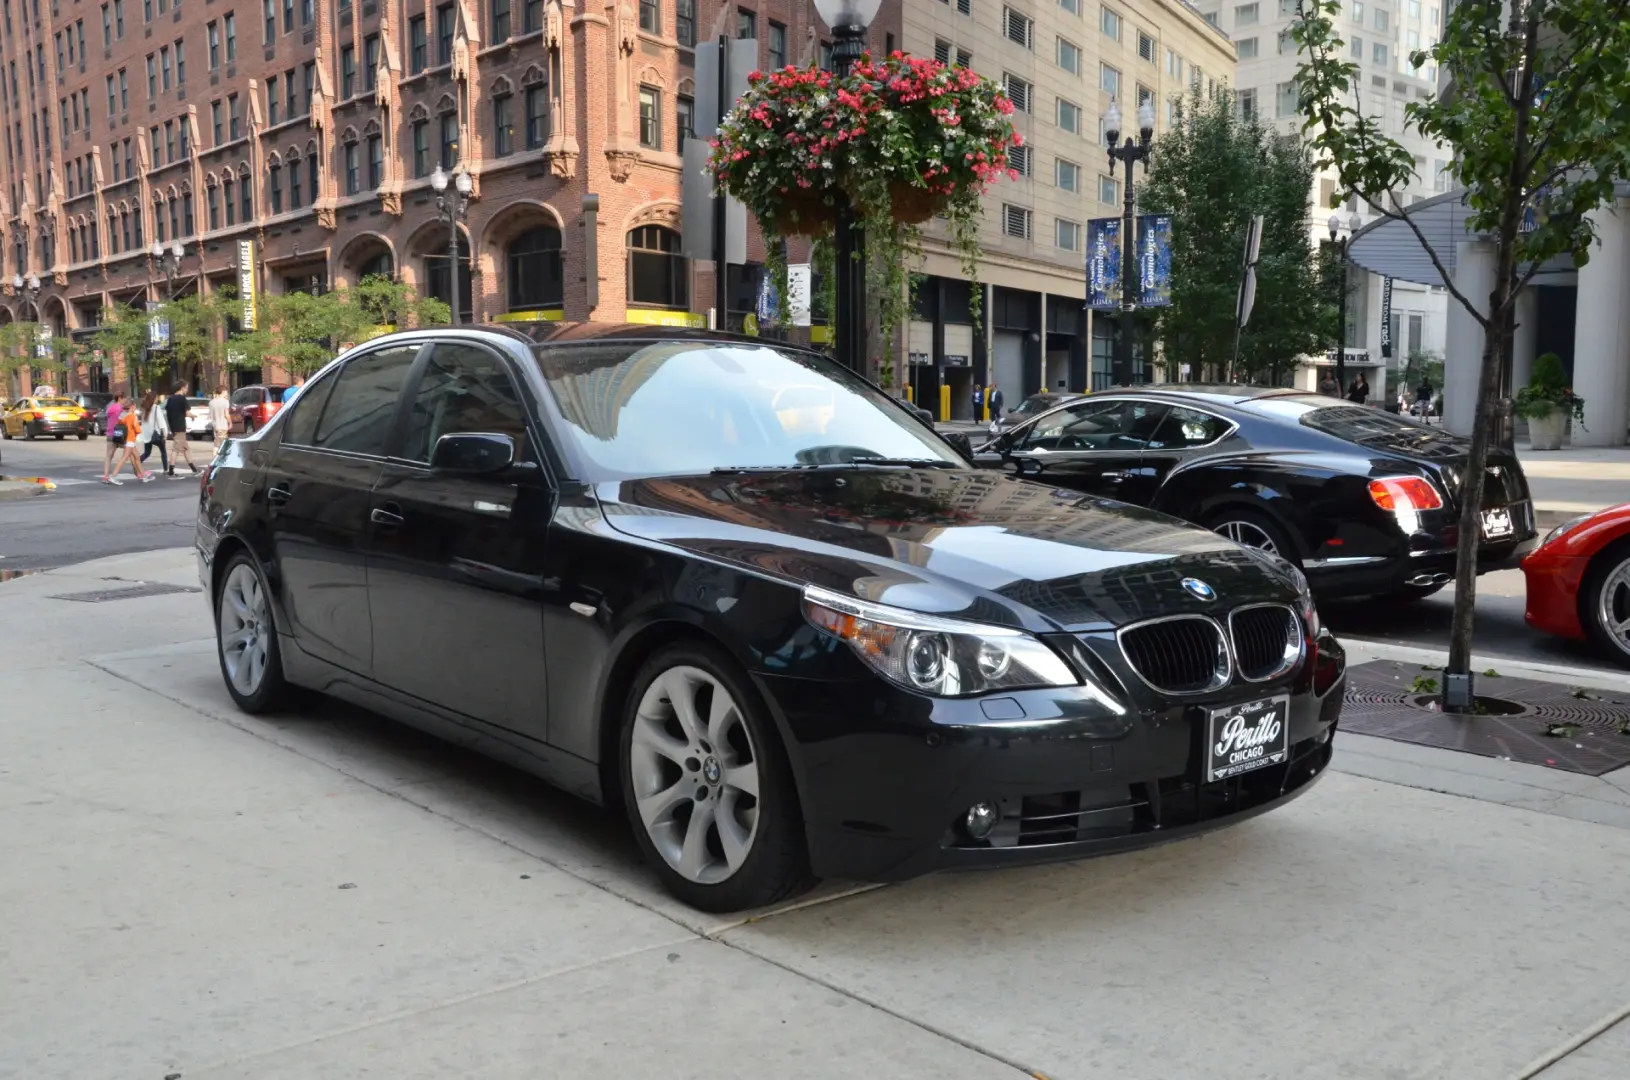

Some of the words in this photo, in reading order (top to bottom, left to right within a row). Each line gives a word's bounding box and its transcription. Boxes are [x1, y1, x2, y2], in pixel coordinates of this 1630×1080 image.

[1095, 232, 1107, 291] Cosmologies
[1145, 229, 1157, 288] Cosmologies
[761, 276, 770, 319] Cosmologies
[1381, 325, 1390, 346] rack
[1214, 711, 1281, 757] Perillo
[1229, 745, 1264, 764] CHICAGO
